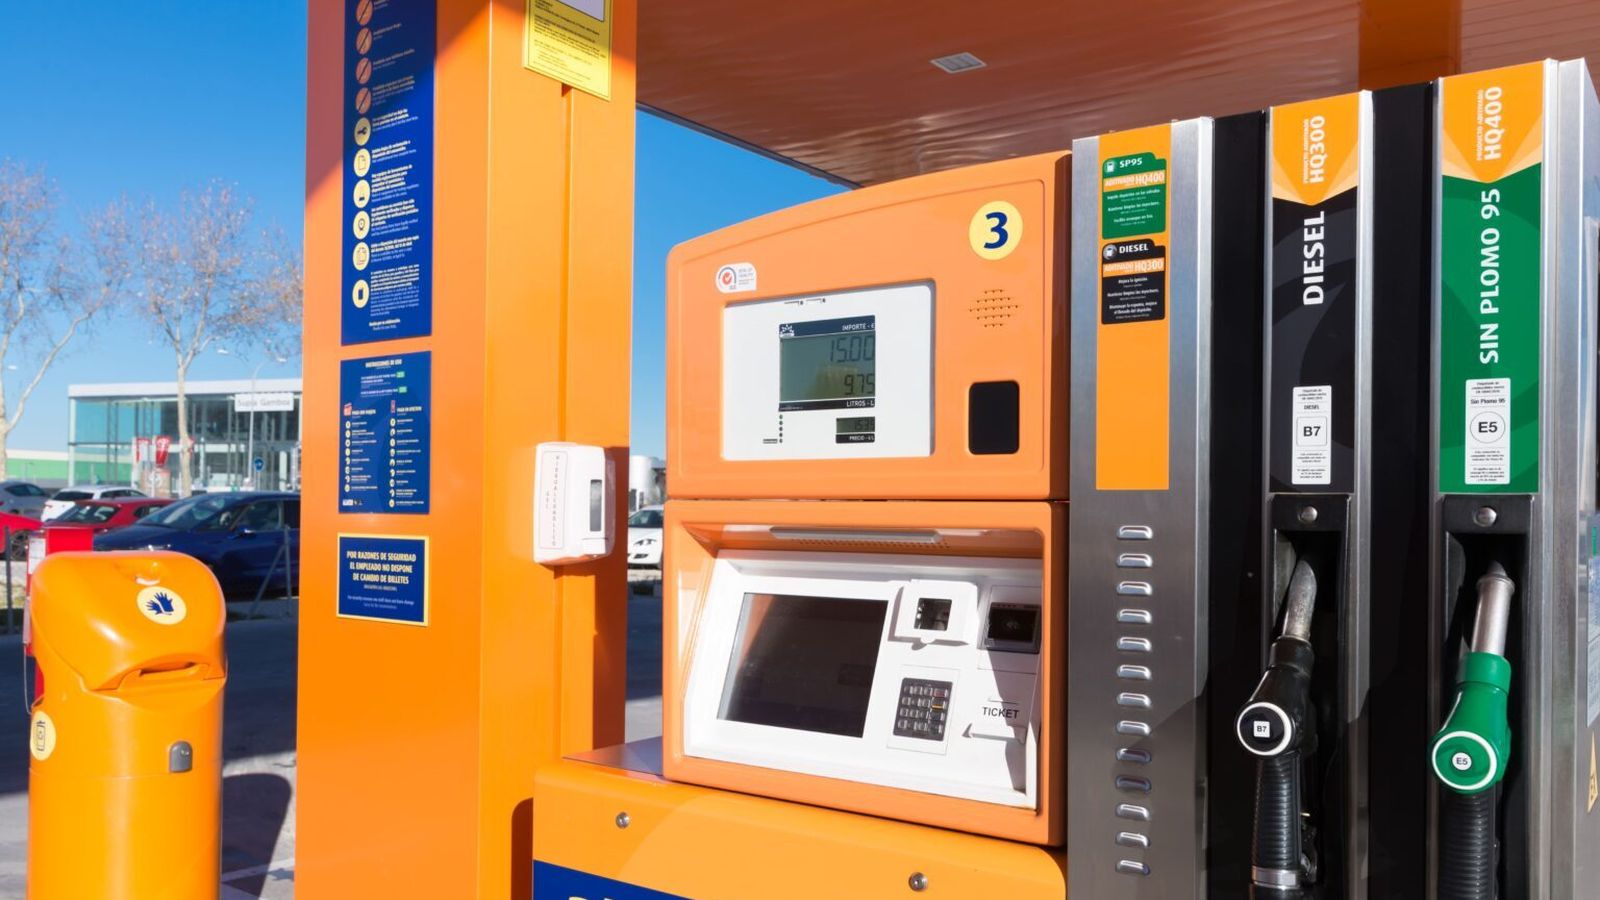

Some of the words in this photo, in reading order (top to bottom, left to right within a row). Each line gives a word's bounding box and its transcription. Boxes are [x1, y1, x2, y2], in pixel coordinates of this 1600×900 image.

[1484, 87, 1504, 160] HQ400
[1310, 115, 1327, 184] HQ300
[1120, 157, 1142, 168] SP95
[1136, 172, 1164, 186] HQ400
[1481, 188, 1500, 219] 95
[984, 212, 1008, 249] 3
[1119, 244, 1149, 253] DIESEL
[1303, 211, 1324, 306] DIESEL
[1135, 260, 1162, 272] HQ300
[1480, 228, 1500, 314] PLOMO
[1480, 323, 1498, 364] SIN
[1303, 426, 1321, 437] B7
[1478, 422, 1498, 433] E5
[358, 551, 380, 560] RAZONES
[388, 553, 416, 562] SEGURIDAD
[356, 562, 381, 571] EMPLEADO
[391, 564, 413, 573] DISPONE
[360, 574, 379, 582] CAMBIO
[388, 576, 409, 584] BILLETES
[982, 706, 1020, 720] TICKET
[1456, 757, 1468, 765] E5
